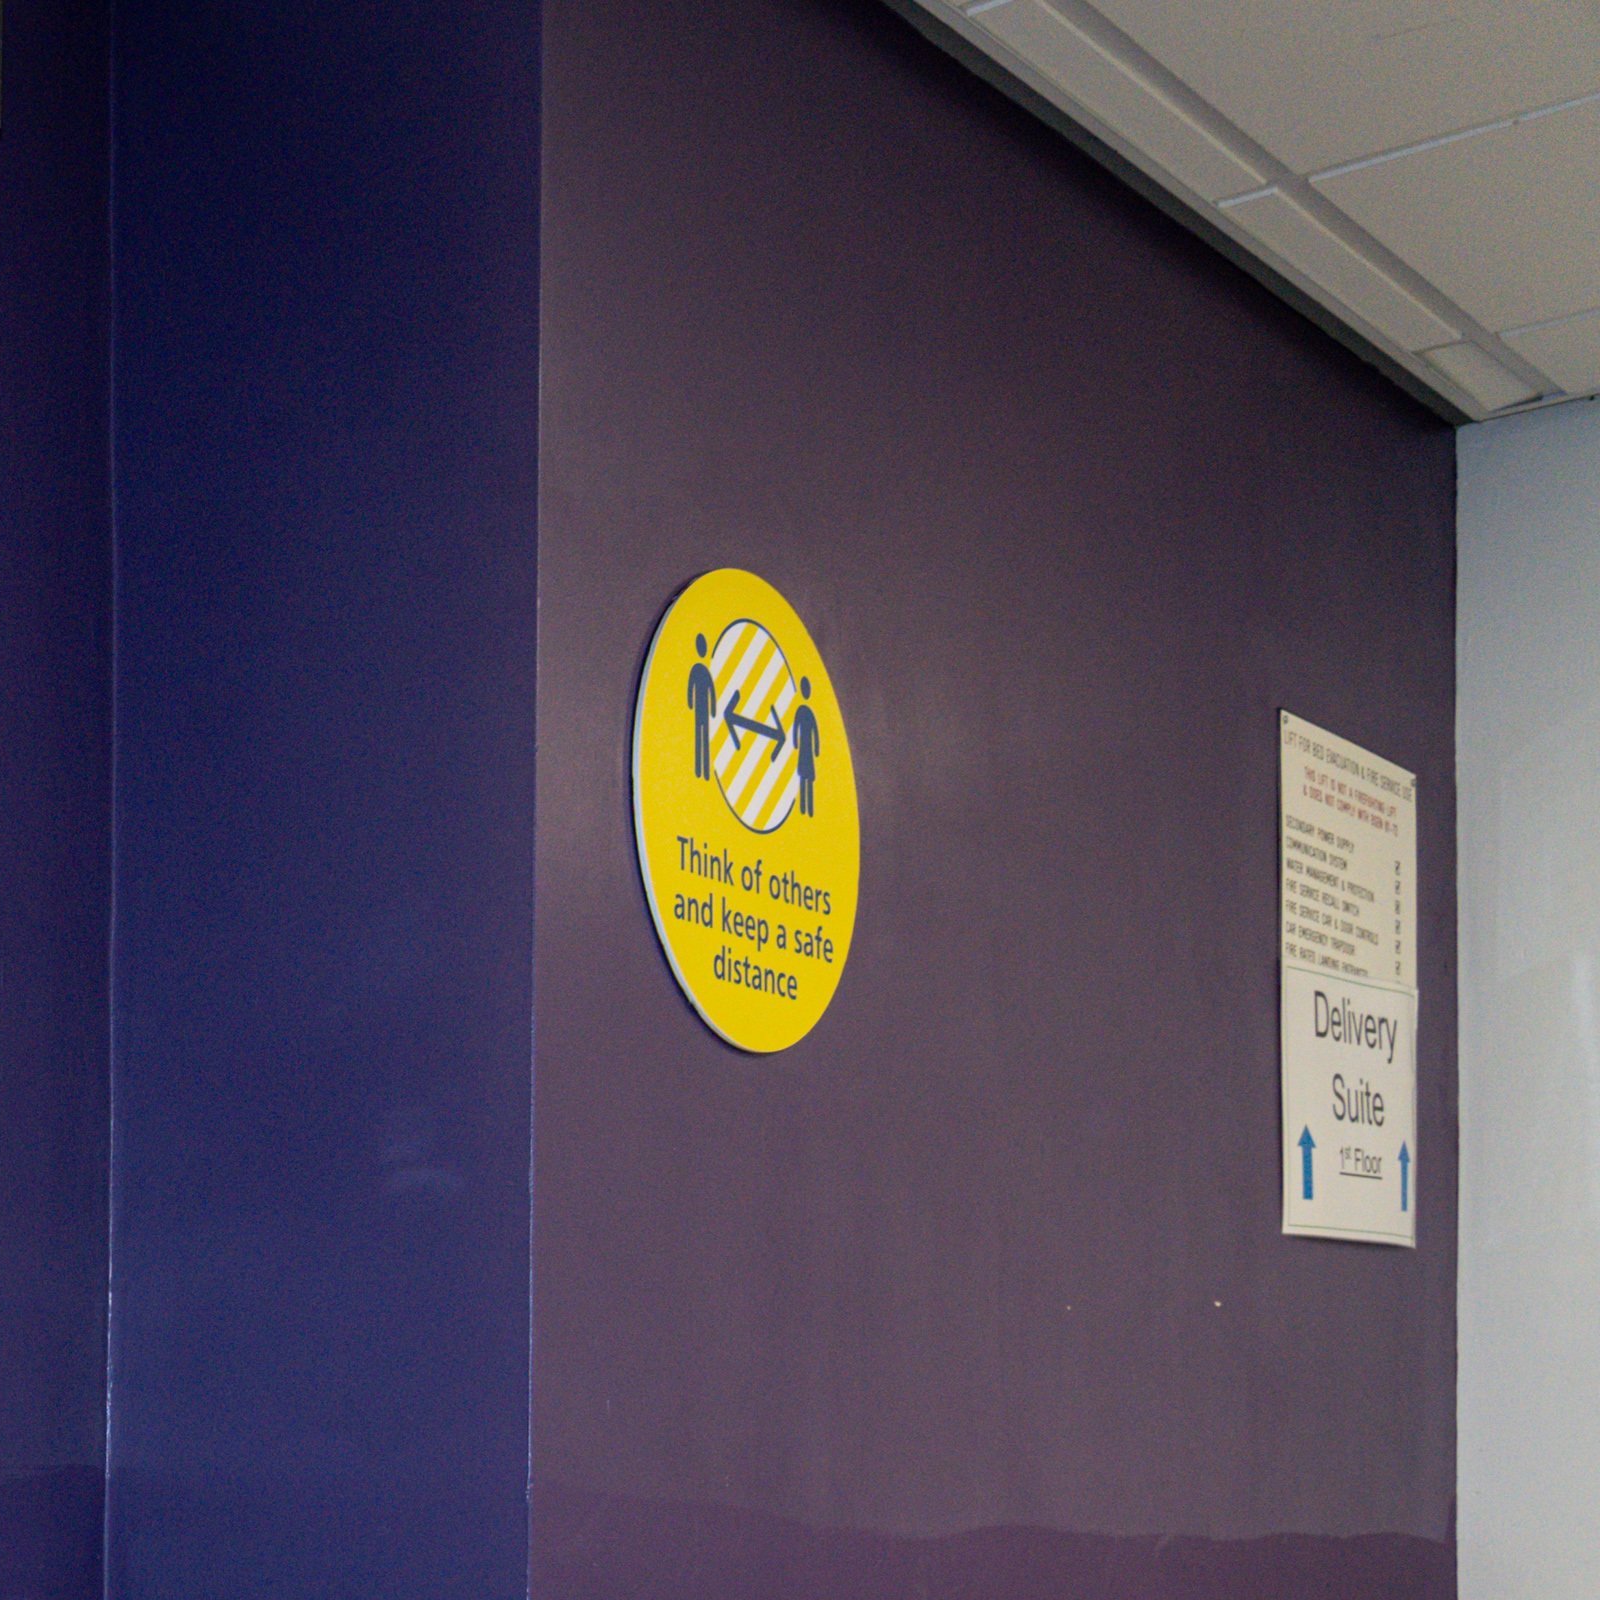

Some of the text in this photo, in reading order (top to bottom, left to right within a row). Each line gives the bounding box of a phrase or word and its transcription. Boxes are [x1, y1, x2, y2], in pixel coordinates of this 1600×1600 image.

[677, 835, 831, 915] Think of others
[674, 893, 834, 963] and keep a safe
[713, 945, 798, 1000] distance
[1314, 990, 1398, 1064] Delivery
[1332, 1073, 1385, 1127] Suite
[1340, 1147, 1382, 1175] 1st Floor
